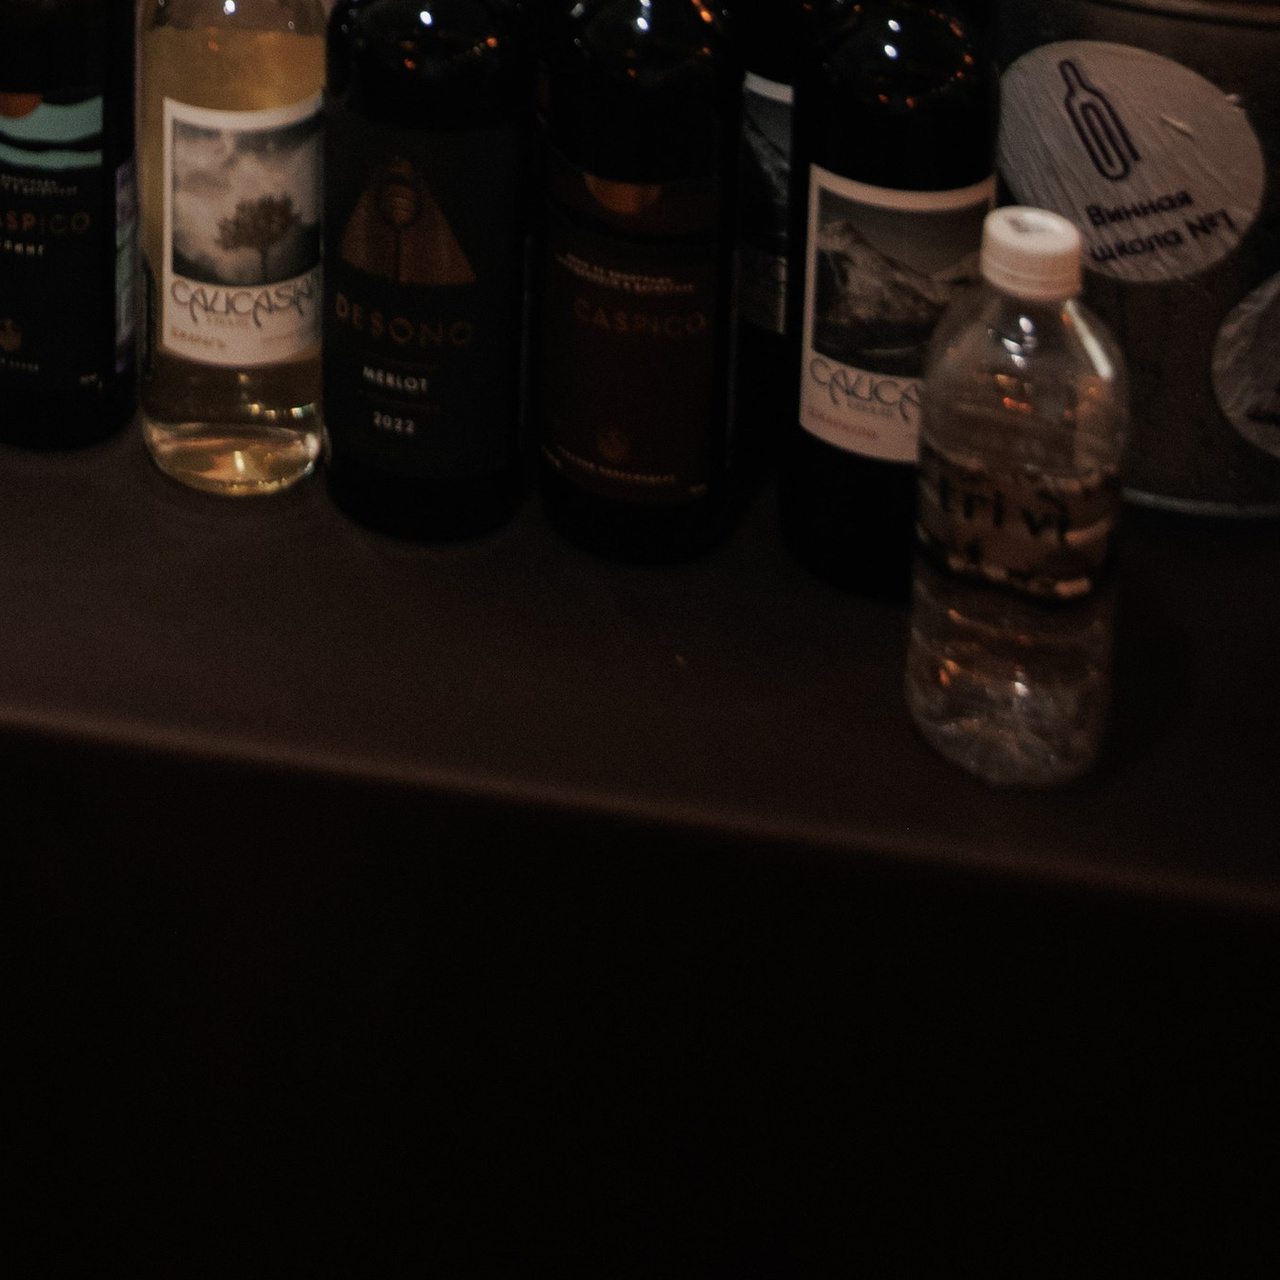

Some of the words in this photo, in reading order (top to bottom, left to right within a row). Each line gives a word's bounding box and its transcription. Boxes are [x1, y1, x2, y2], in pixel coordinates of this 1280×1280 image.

[1085, 190, 1193, 228] Винная
[1089, 229, 1182, 262] школа
[1185, 208, 1235, 239] №1
[335, 290, 476, 347] DESONO
[572, 296, 708, 338] CASPICO
[361, 366, 429, 392] MERLOT
[372, 409, 415, 438] 2022
